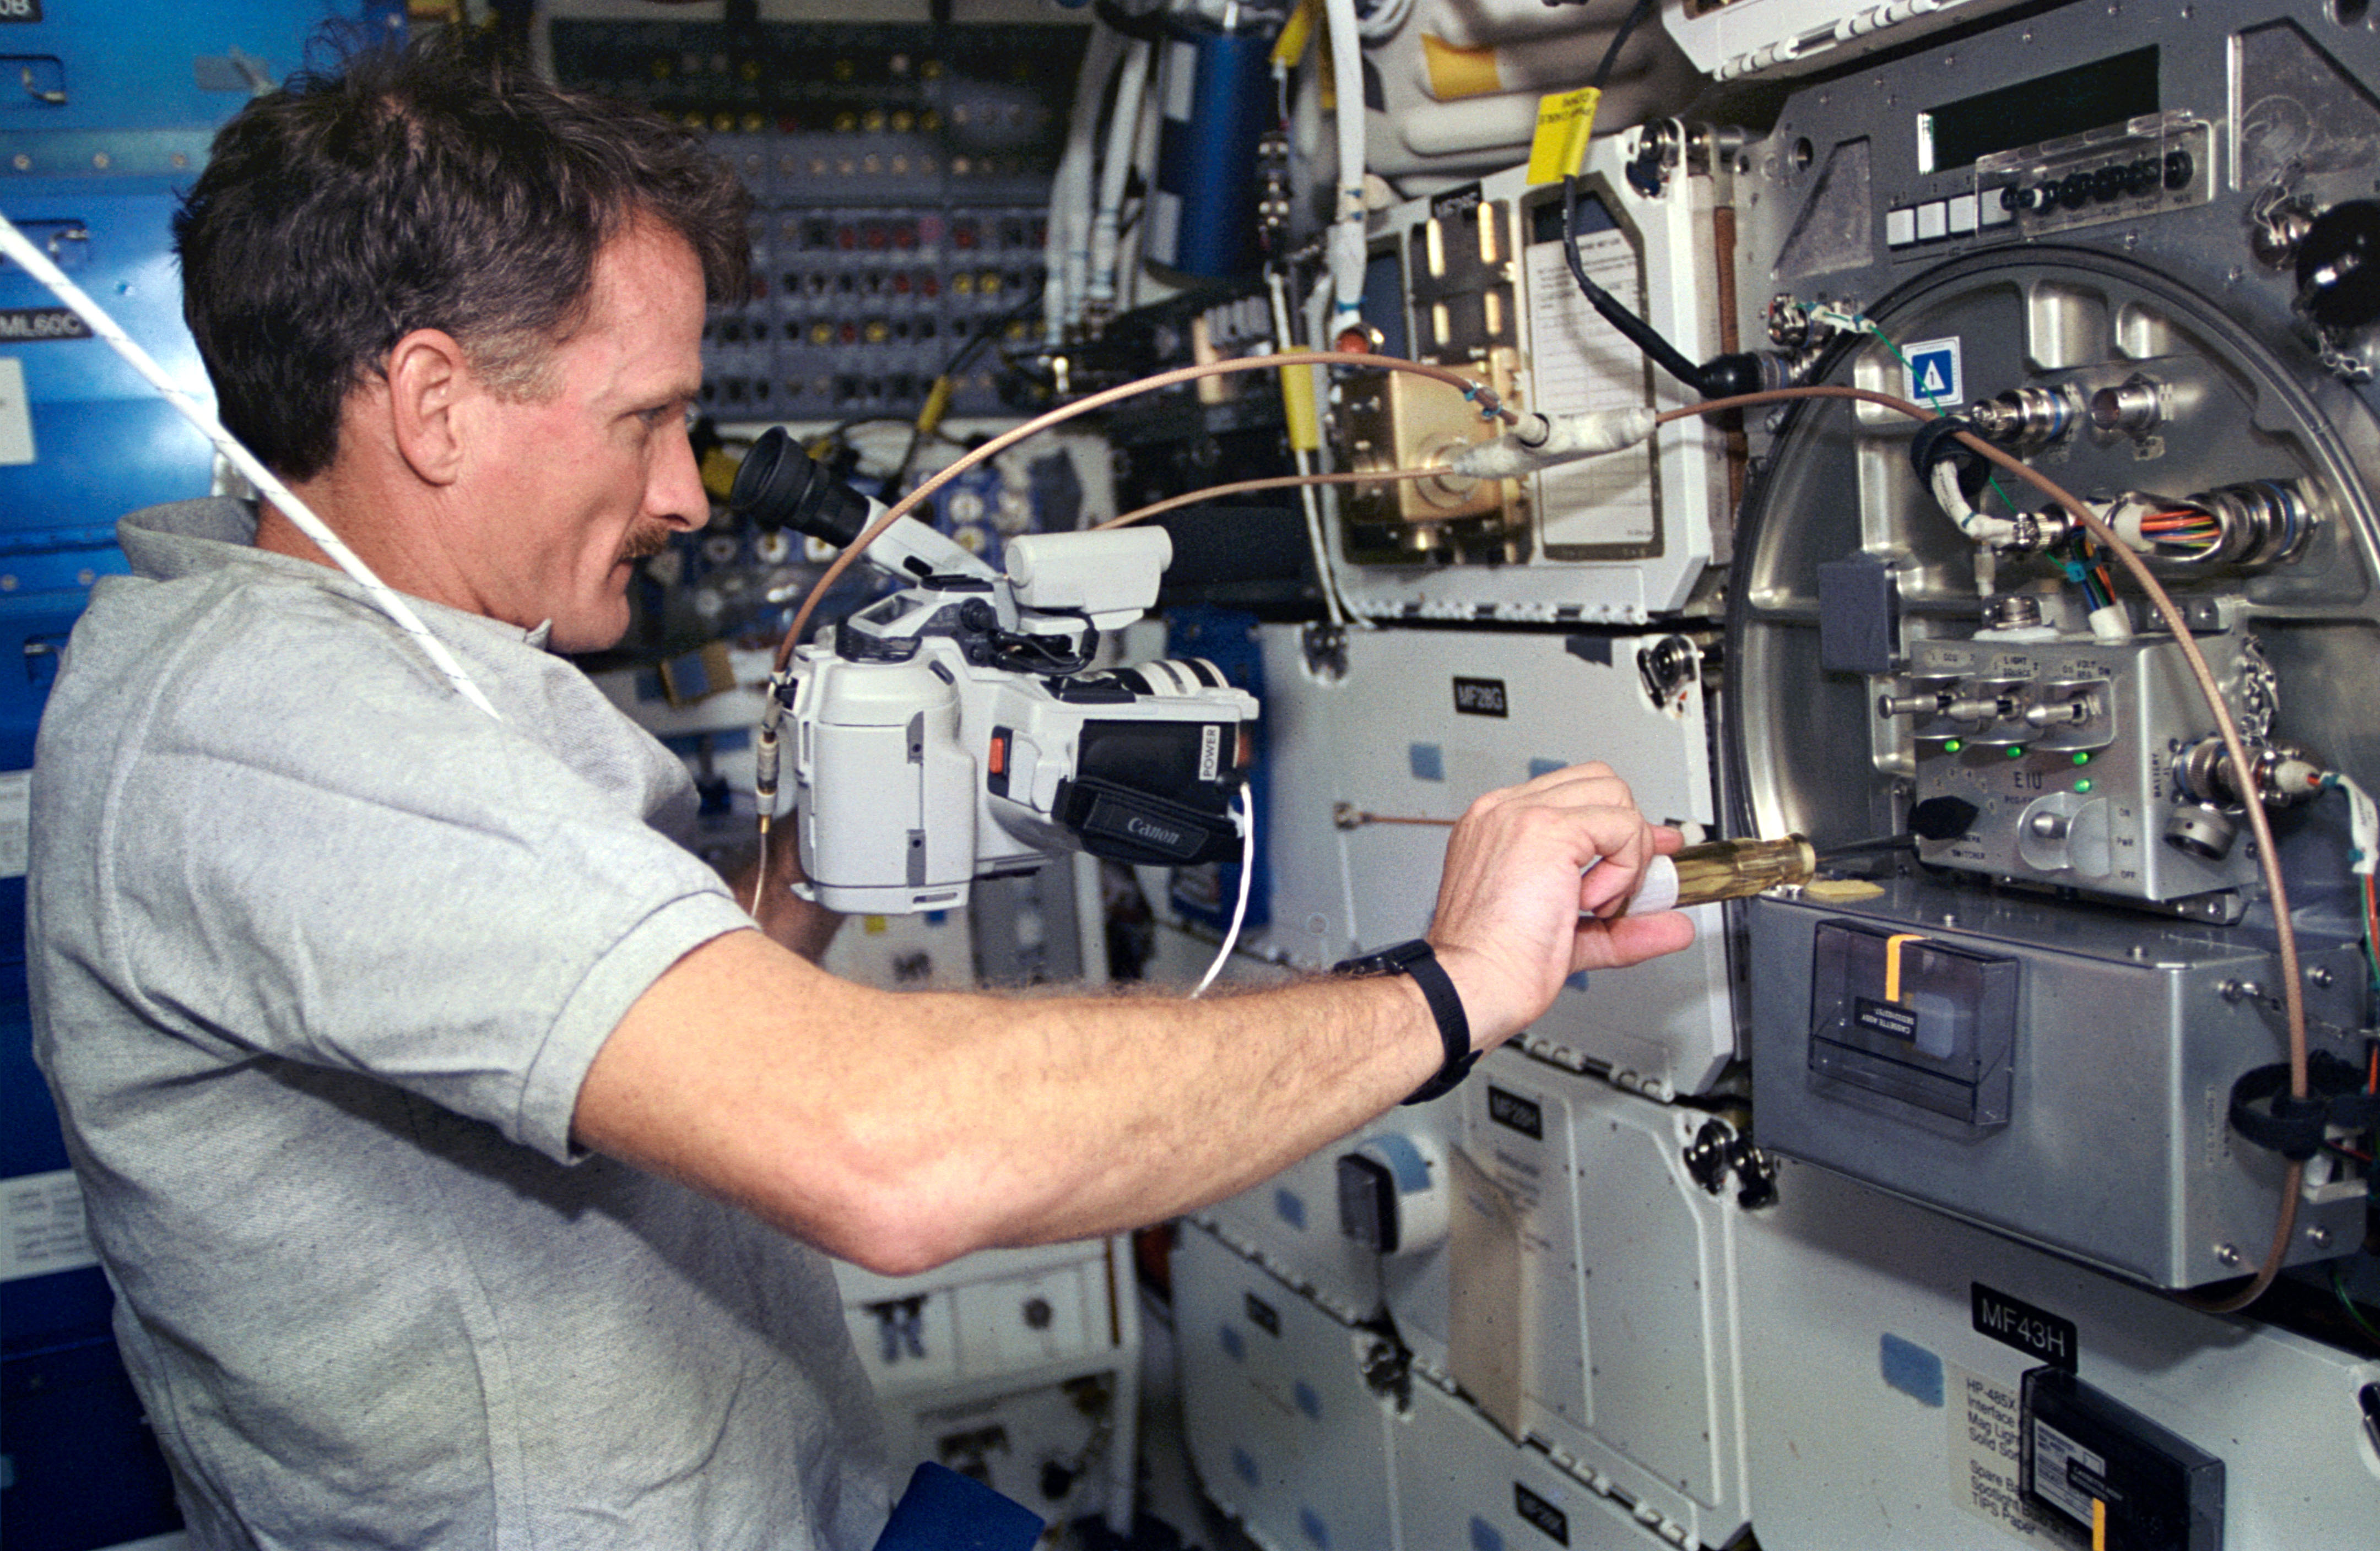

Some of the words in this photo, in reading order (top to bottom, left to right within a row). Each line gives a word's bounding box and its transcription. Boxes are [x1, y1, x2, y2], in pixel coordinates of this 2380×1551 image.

[2004, 656, 2027, 665] LIGHT
[1203, 729, 1216, 777] POWER
[2014, 771, 2042, 789] EIU
[2151, 752, 2162, 798] BATTERY
[1127, 817, 1180, 844] Canon
[2121, 871, 2135, 879] OFF
[1982, 1297, 2064, 1357] MF43H
[1968, 1393, 2015, 1428] Interface
[1968, 1411, 1992, 1435] Mag
[1969, 1427, 1995, 1451] Solid
[1970, 1460, 2003, 1487] Spare
[1972, 1490, 1999, 1517] TIPS
[2003, 1501, 2035, 1535] Paper
